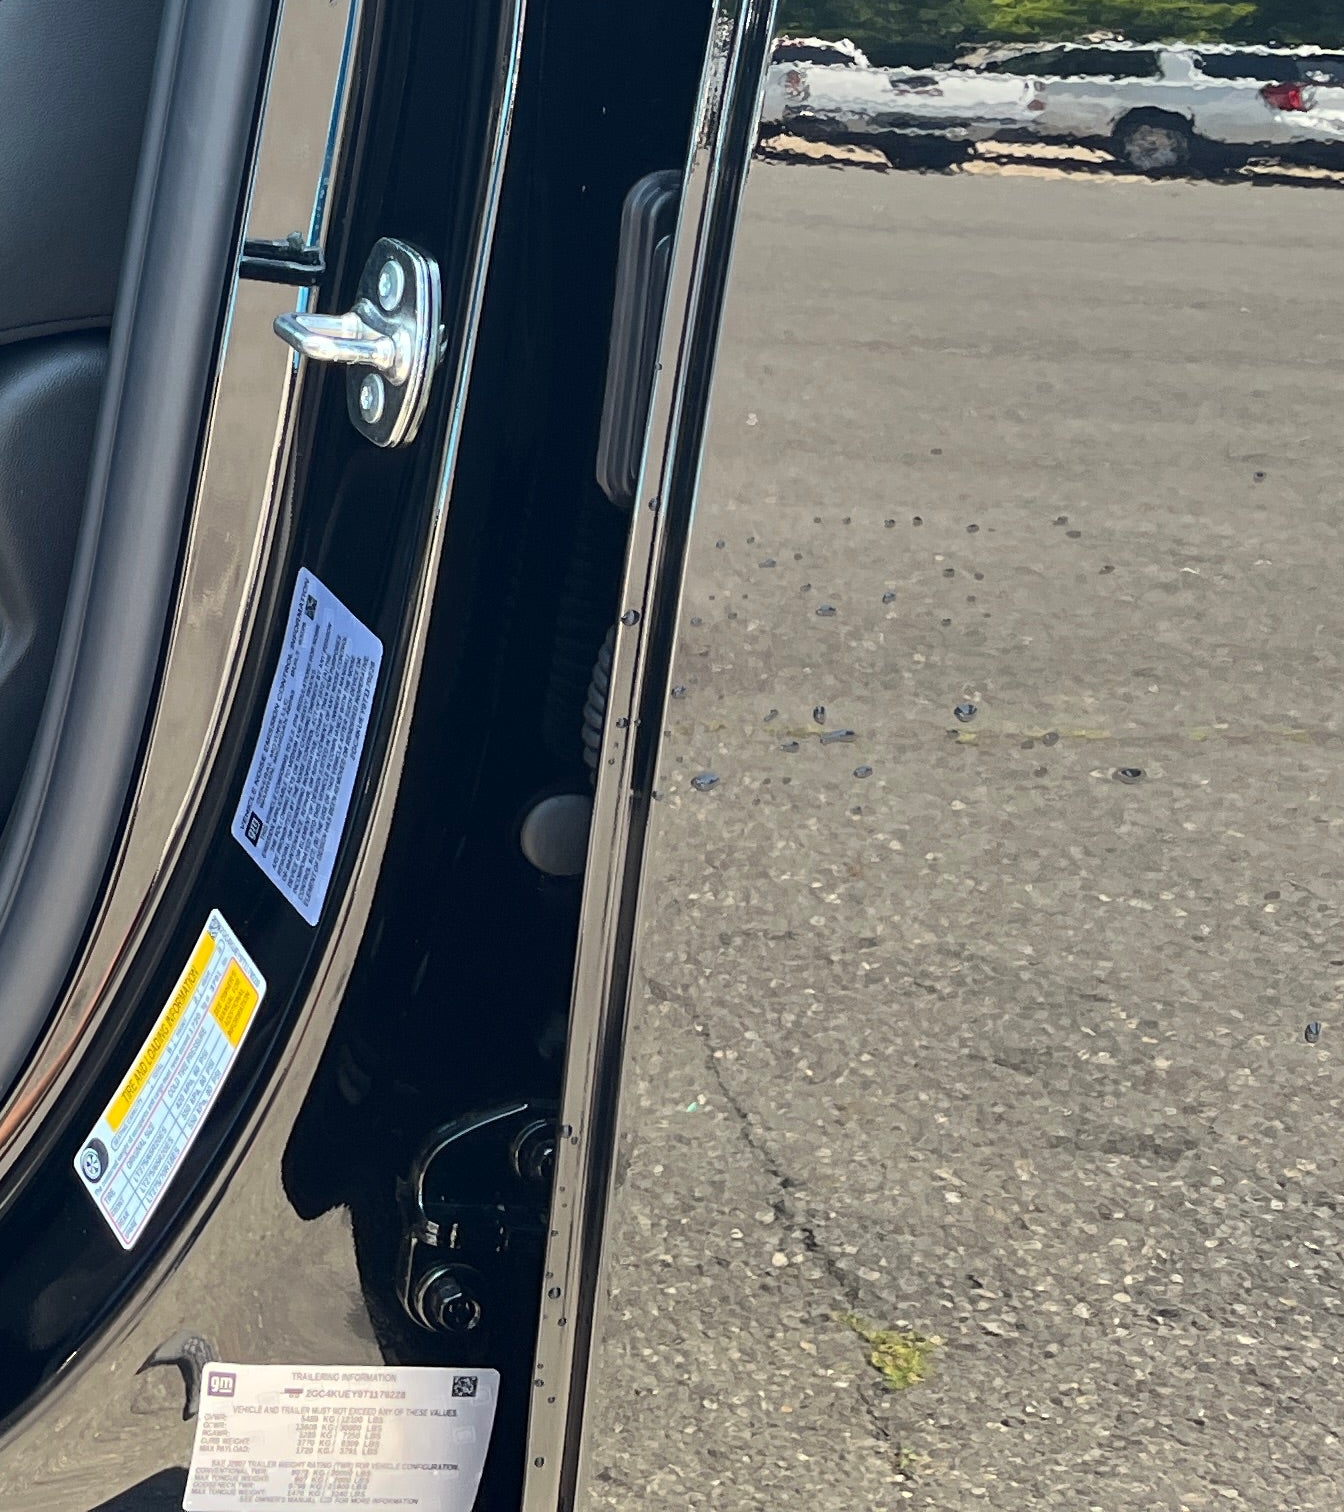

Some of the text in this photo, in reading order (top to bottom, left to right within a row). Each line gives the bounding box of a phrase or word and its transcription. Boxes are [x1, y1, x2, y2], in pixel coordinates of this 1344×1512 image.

[239, 786, 256, 833] VEHICLE
[253, 753, 266, 785] NOISE
[263, 702, 279, 752] EMISSION
[277, 654, 292, 701] CONTROL
[290, 577, 309, 649] INFORMATION
[121, 965, 198, 1103] TIRE AND LOADING INFORMATION
[185, 1026, 206, 1063] PRESSURE
[208, 1375, 234, 1392] gm
[290, 1371, 397, 1383] TRAILERING INFORMATION
[231, 1404, 263, 1414] VEHICLE
[262, 1405, 279, 1414] AND
[280, 1406, 310, 1415] TRAILER
[377, 1407, 393, 1416] ANY
[392, 1408, 404, 1416] OF
[406, 1408, 428, 1416] THESE
